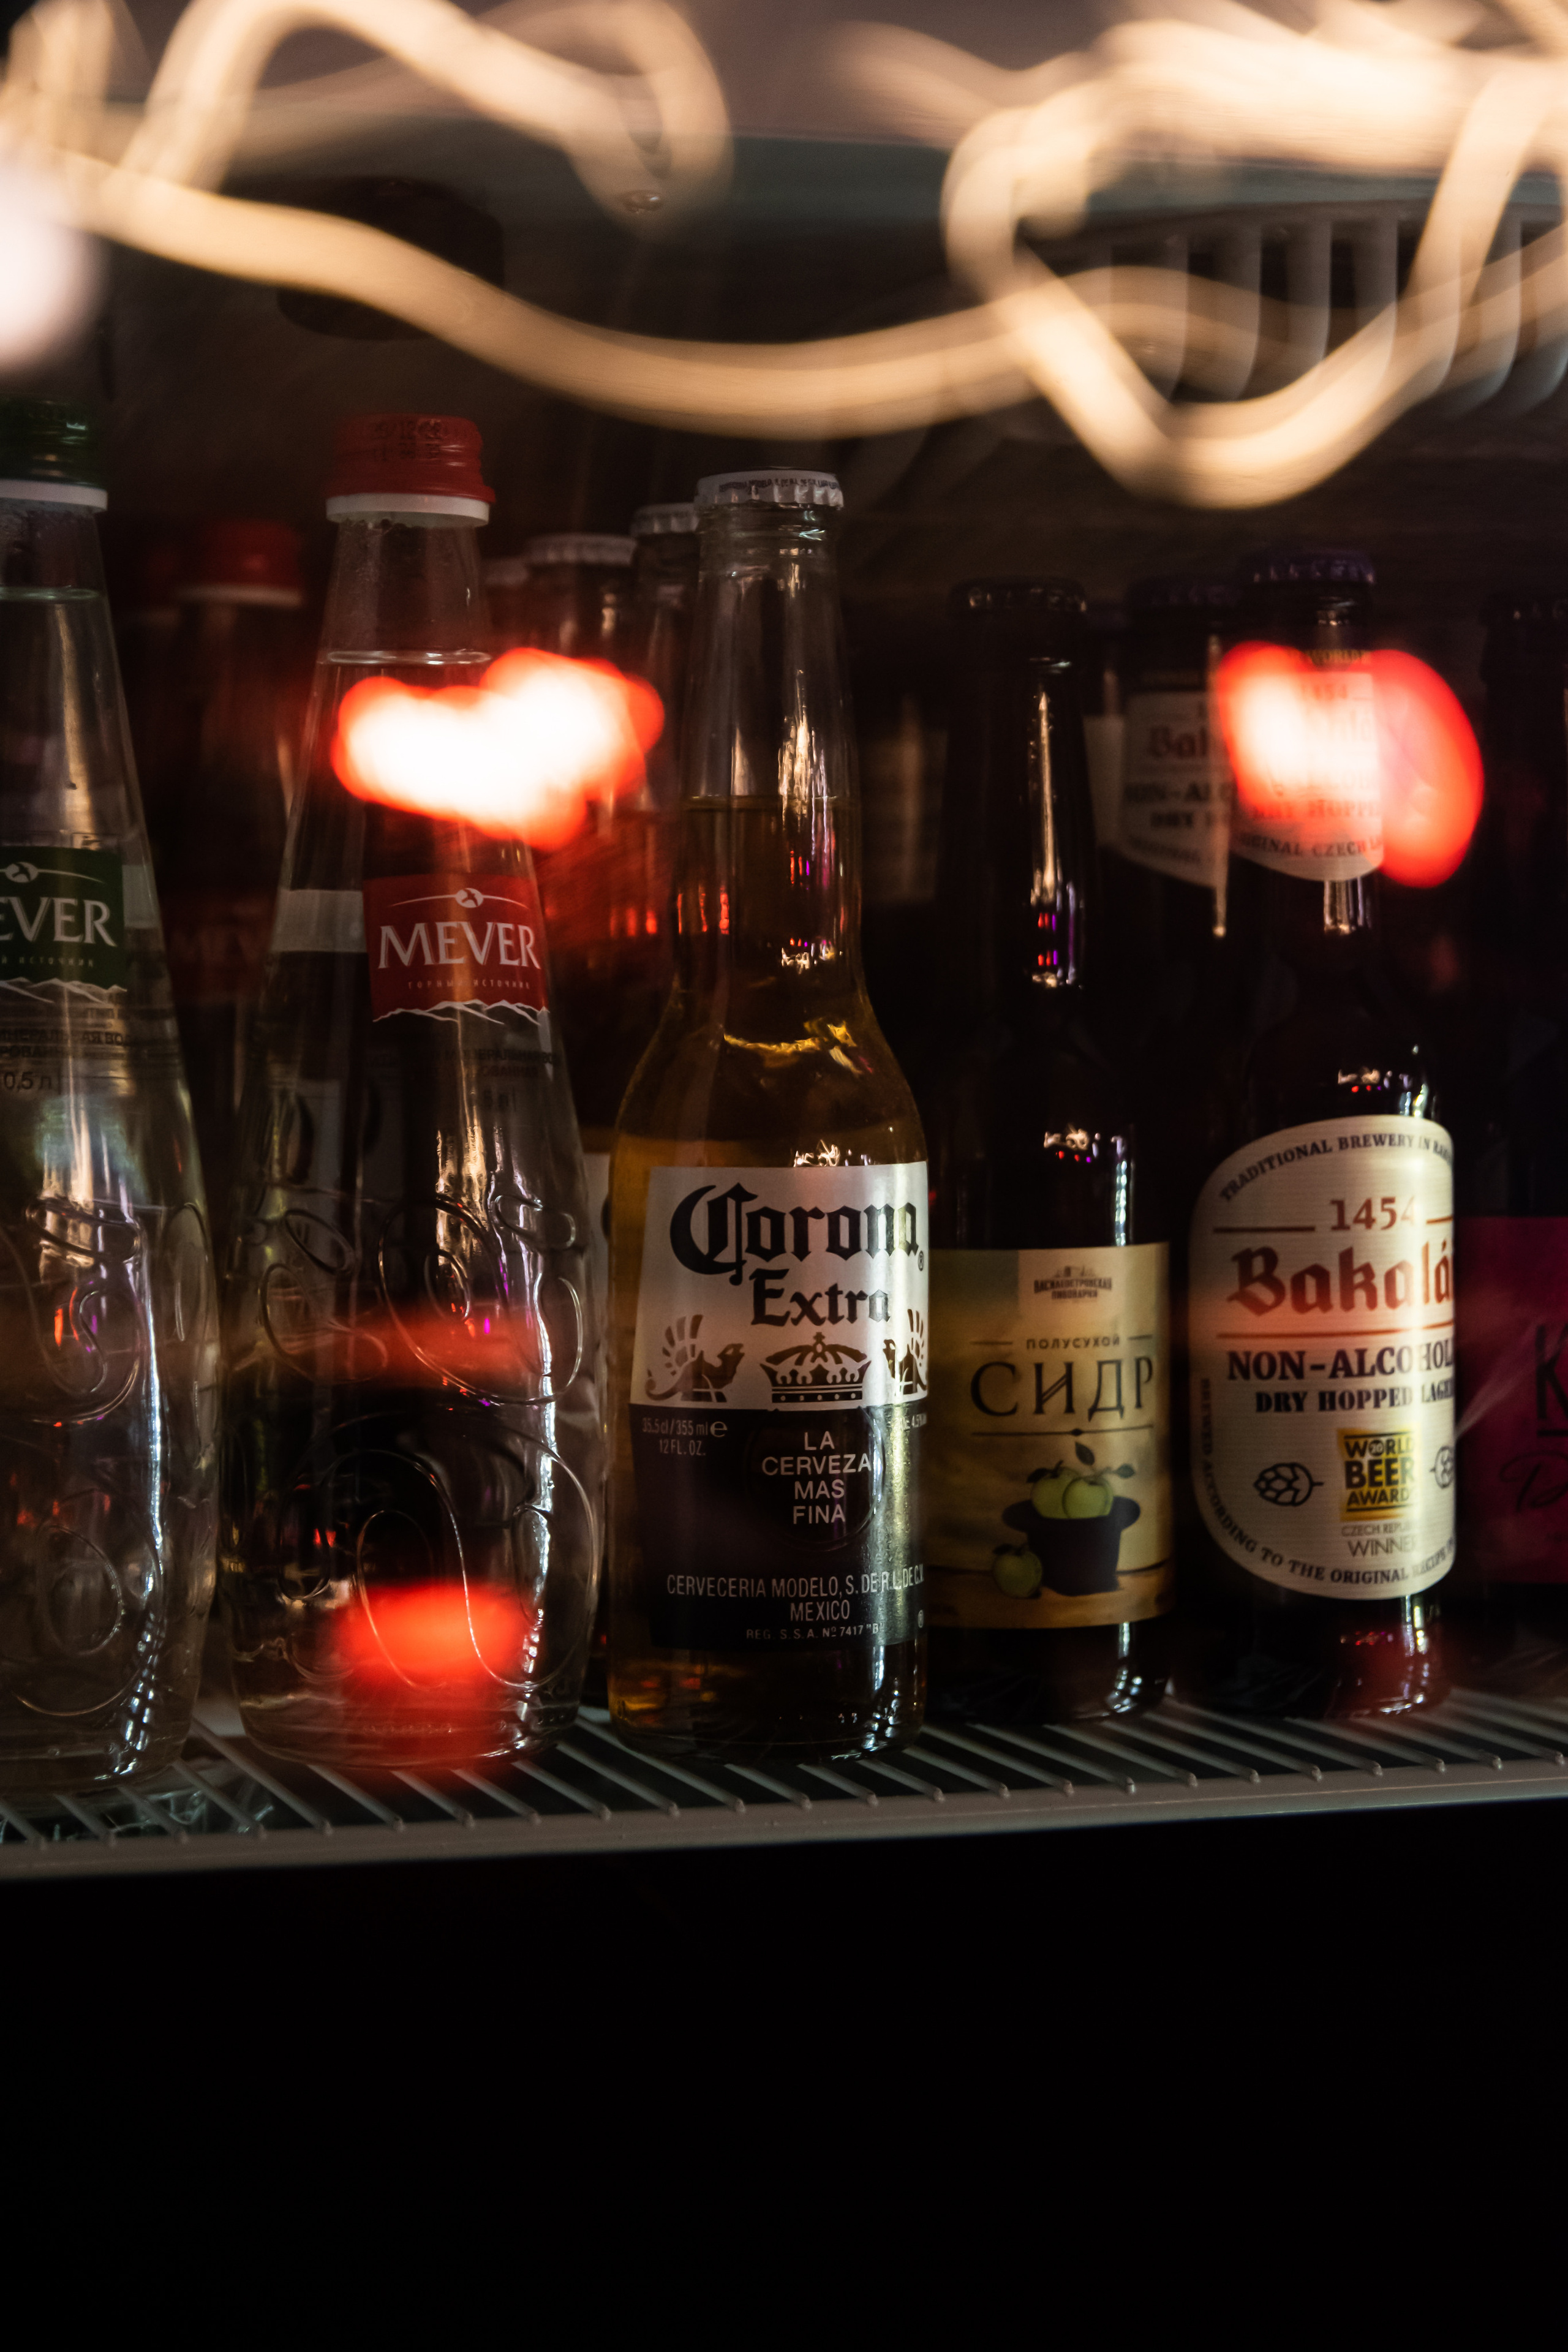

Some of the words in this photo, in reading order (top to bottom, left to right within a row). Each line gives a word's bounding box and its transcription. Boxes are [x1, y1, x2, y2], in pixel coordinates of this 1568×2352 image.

[378, 920, 541, 970] MEVER
[1219, 1139, 1333, 1202] TRADITIONAL
[1338, 1133, 1415, 1152] BREWERY
[1330, 1195, 1416, 1232] 1454
[669, 1182, 919, 1286] Corona
[748, 1267, 892, 1327] Extra
[1025, 1333, 1121, 1350] ПОЛУСУХОЙ
[970, 1355, 1153, 1422] СИДР
[1255, 1390, 1308, 1413] DRY
[1318, 1385, 1414, 1412] HOPPED
[803, 1430, 835, 1451] LA
[761, 1452, 872, 1477] CERVEZA
[1344, 1457, 1415, 1490] BEER
[794, 1479, 845, 1500] MAS
[793, 1504, 846, 1525] FINA
[1341, 1524, 1381, 1537] CZECH
[1261, 1547, 1284, 1567] TO
[1288, 1559, 1326, 1581] THE
[1330, 1568, 1409, 1586] ORIGINAL
[666, 1574, 766, 1598] CERVECERIA
[771, 1575, 843, 1599] MODELO,
[845, 1574, 859, 1596] S.
[861, 1572, 878, 1593] DE
[790, 1599, 851, 1623] MEXICO
[745, 1628, 774, 1640] REG.
[839, 1624, 864, 1637] 7417
